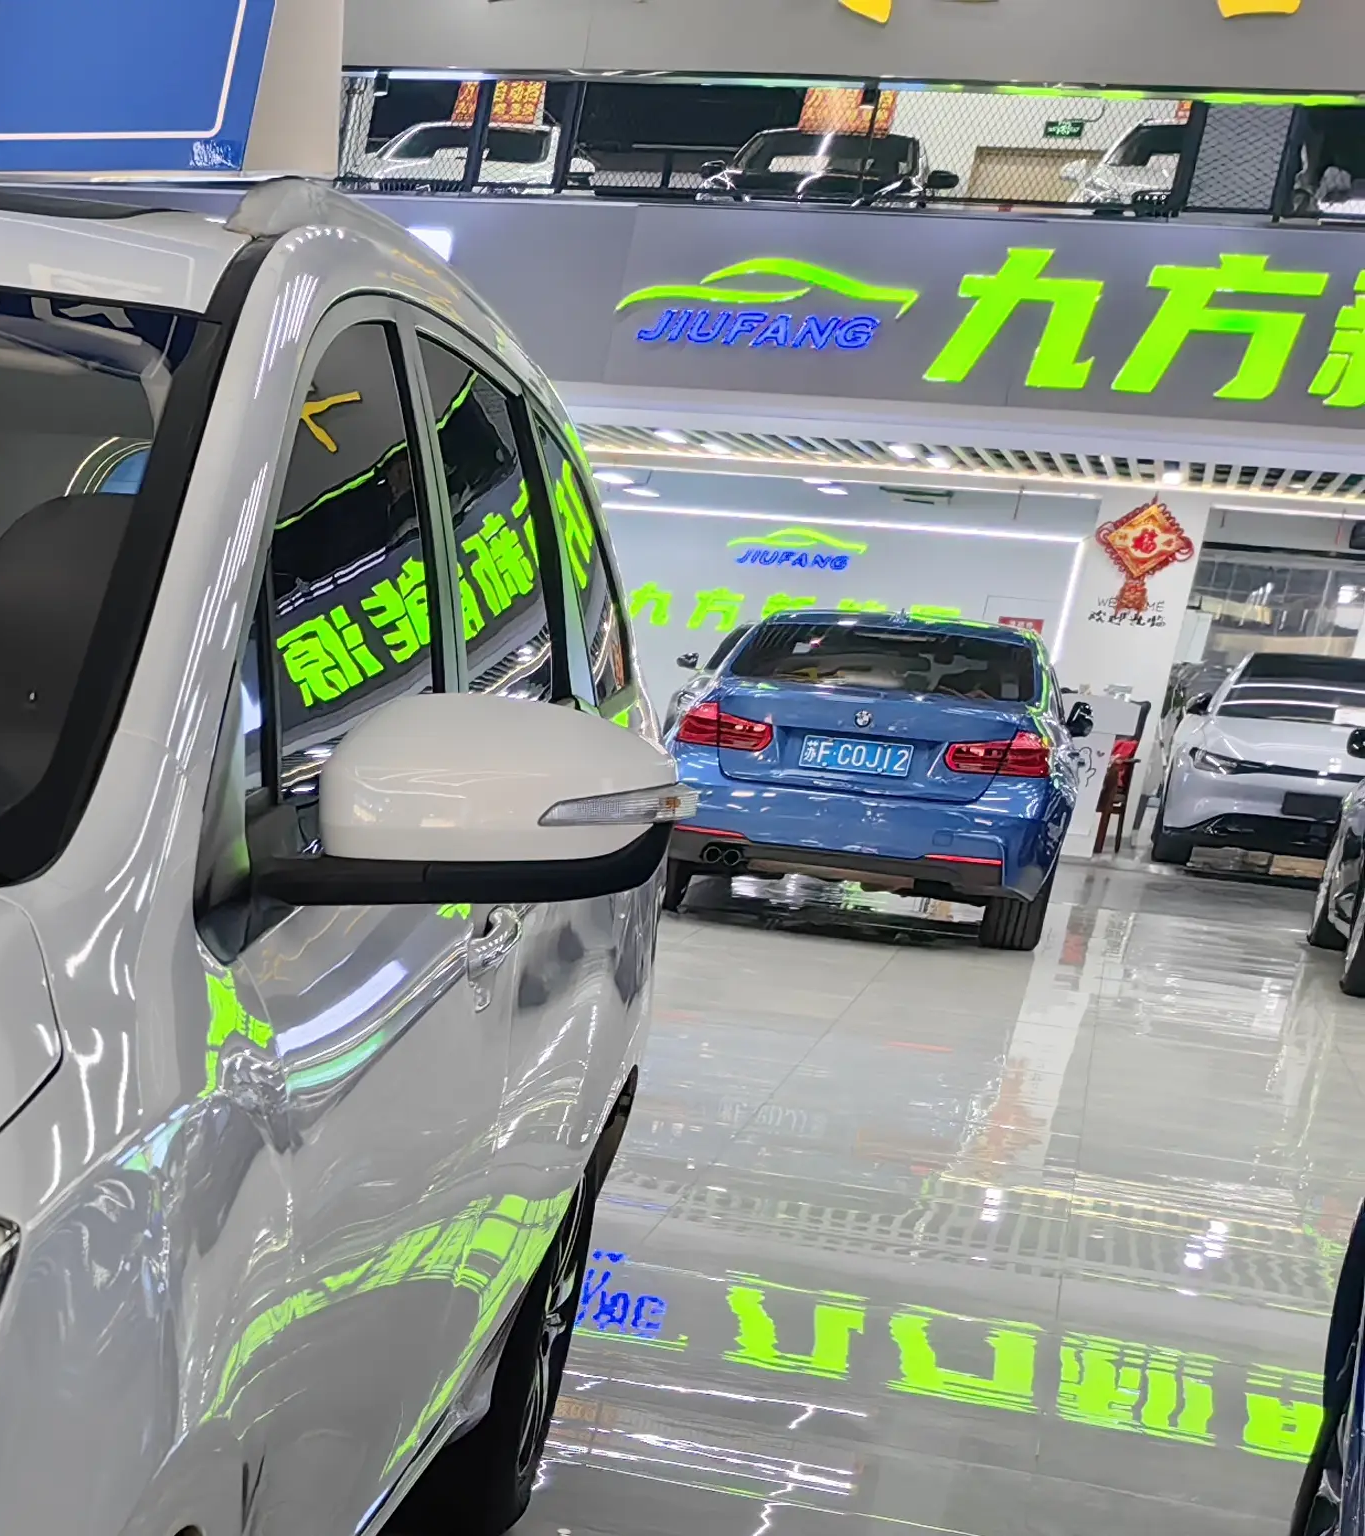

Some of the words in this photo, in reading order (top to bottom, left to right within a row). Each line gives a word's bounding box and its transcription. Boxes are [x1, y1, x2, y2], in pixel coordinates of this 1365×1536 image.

[636, 308, 882, 350] JIUFANG
[735, 547, 851, 571] JIUFANG
[1097, 597, 1166, 613] WEME
